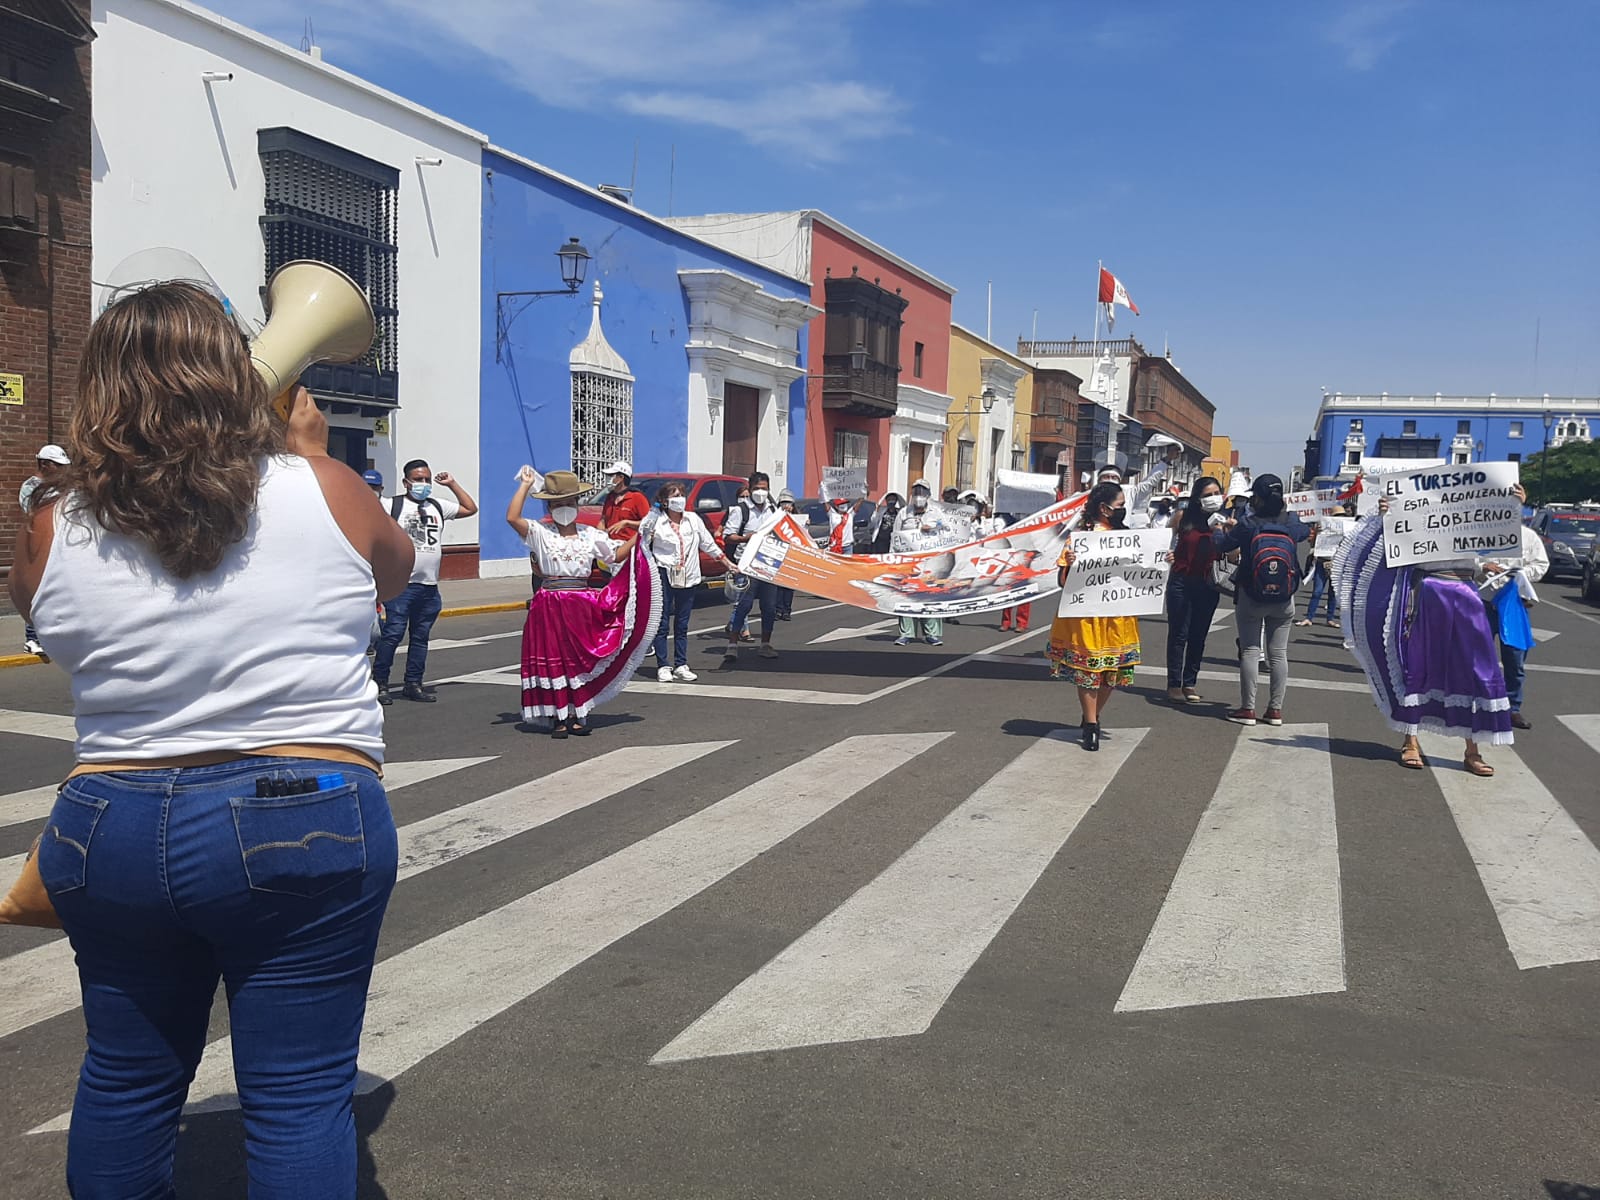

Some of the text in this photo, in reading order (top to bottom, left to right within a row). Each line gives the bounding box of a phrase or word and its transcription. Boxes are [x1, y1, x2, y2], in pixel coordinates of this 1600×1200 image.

[1386, 471, 1486, 496] EL TURISMO
[1404, 497, 1430, 511] ESTA
[1394, 509, 1512, 534] EL GOBIERNO
[1073, 535, 1141, 553] ES MEJOR
[1389, 533, 1518, 559] LO ESTA MATANDO
[1077, 551, 1167, 573] MORIR DE PI
[1085, 573, 1112, 587] QUE
[1070, 584, 1163, 605] DE RODILLAS
